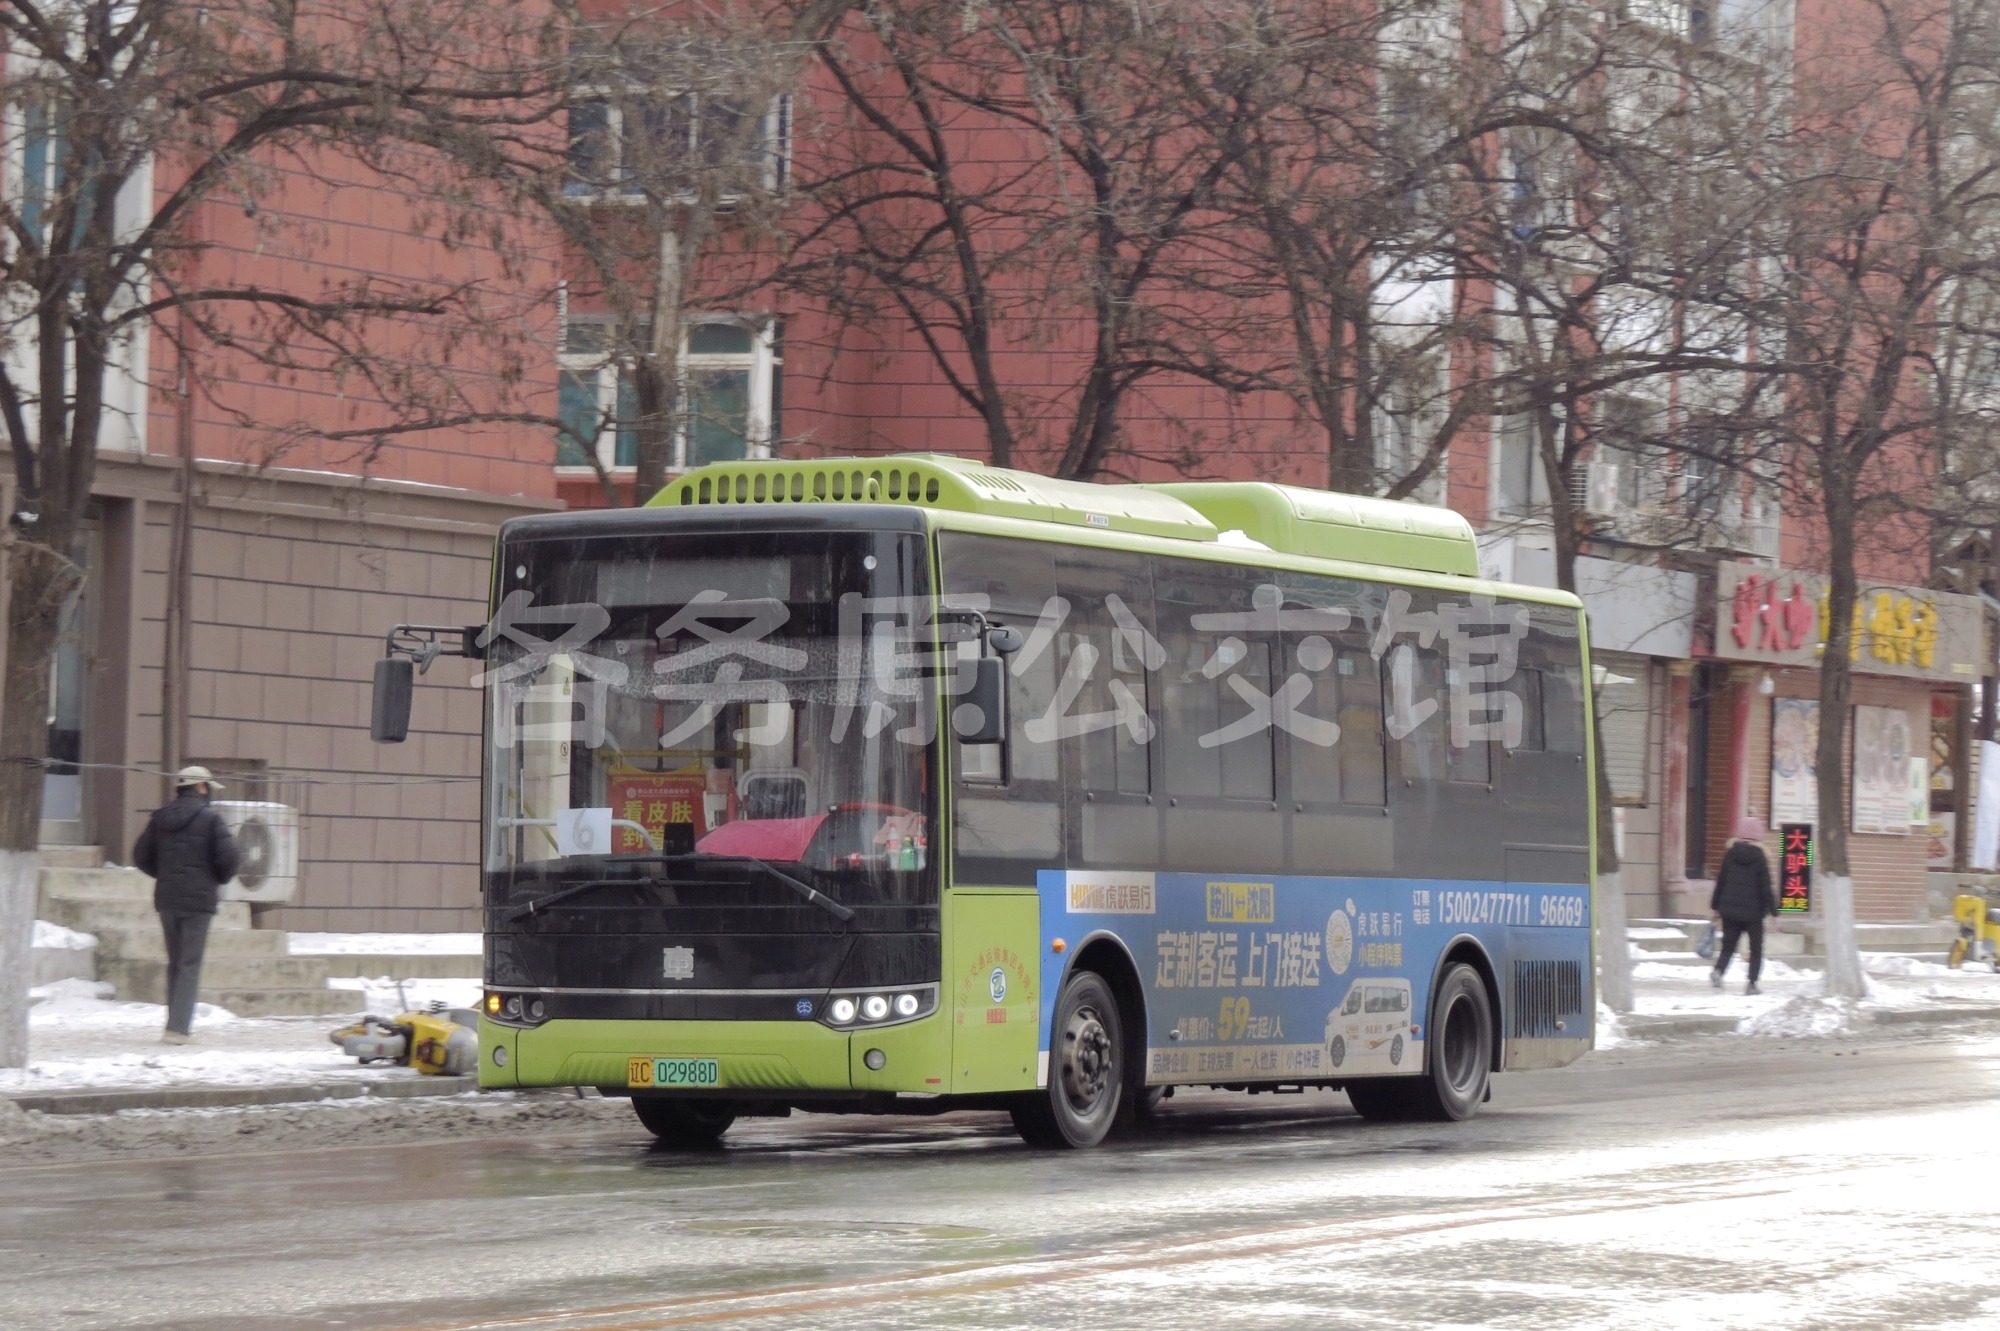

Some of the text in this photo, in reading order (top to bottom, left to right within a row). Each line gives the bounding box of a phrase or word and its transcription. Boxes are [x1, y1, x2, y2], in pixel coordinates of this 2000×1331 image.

[623, 800, 693, 824] 看皮肤
[573, 808, 595, 850] 6
[1785, 829, 1808, 897] 大驴头
[1106, 885, 1151, 909] 虎跃易行
[1210, 886, 1271, 919] 鞍山 沈阳
[1413, 890, 1430, 906] 订票
[1438, 891, 1583, 926] 15002477711 96669
[1358, 912, 1402, 936] 虎跃易行
[1413, 908, 1430, 924] 电话
[1155, 930, 1321, 988] 定制客运 上门接送
[1358, 943, 1403, 967] 小程序购票
[658, 1062, 718, 1083] 02988D
[1153, 1052, 1189, 1074] 品牌企业
[1197, 1051, 1234, 1073] 正规发票
